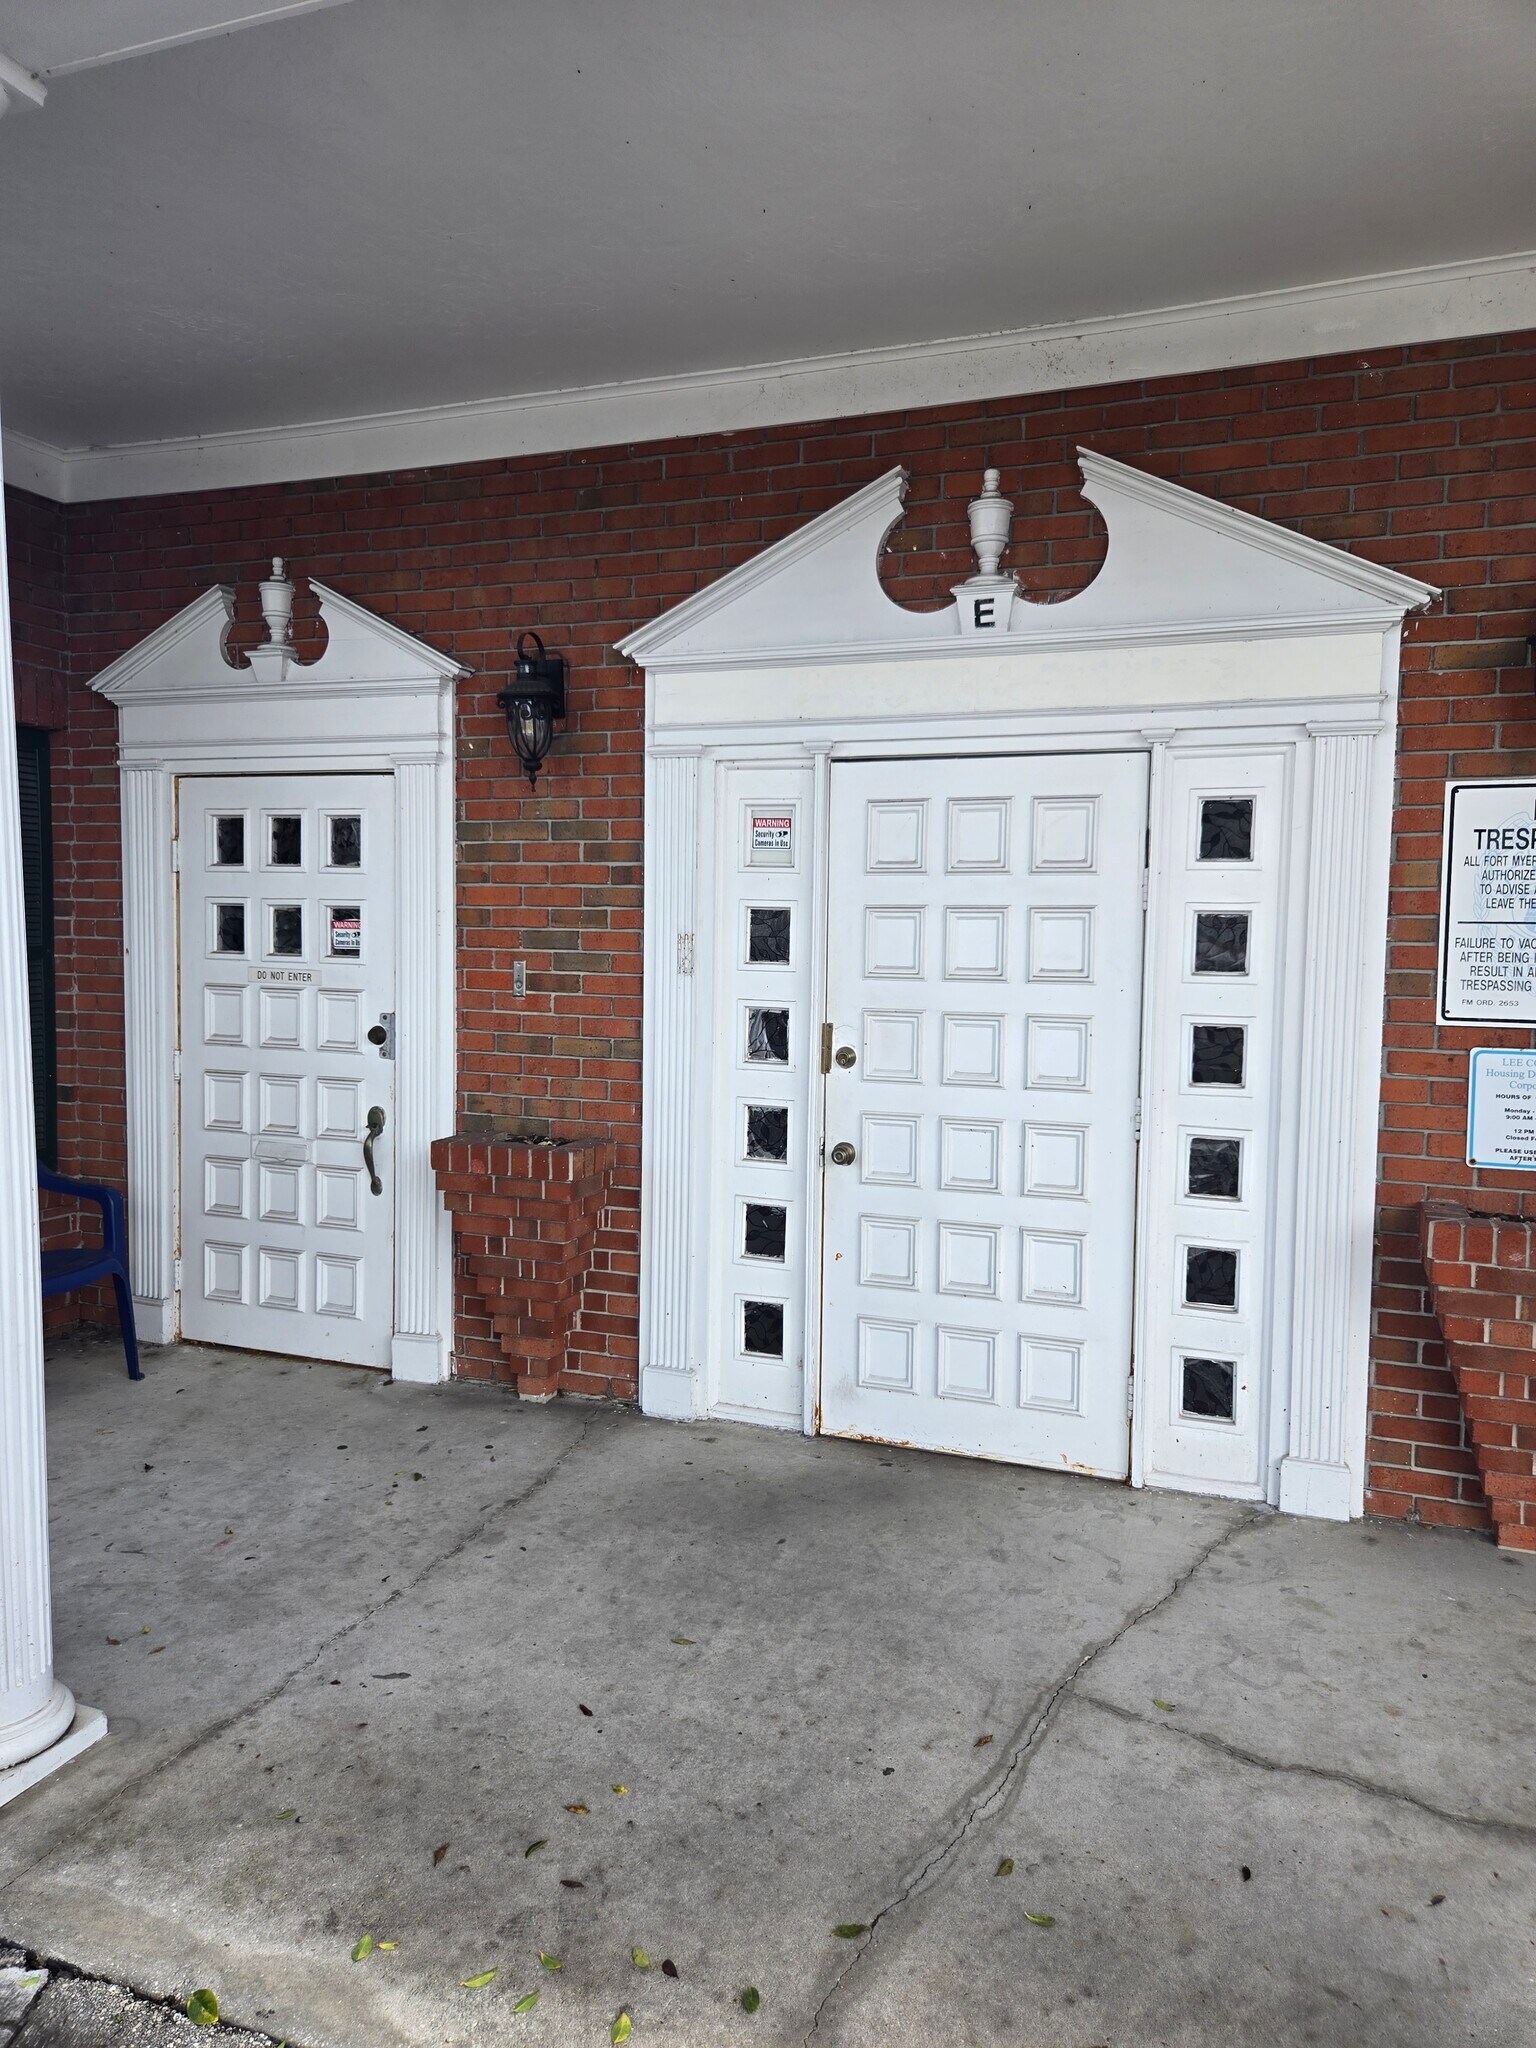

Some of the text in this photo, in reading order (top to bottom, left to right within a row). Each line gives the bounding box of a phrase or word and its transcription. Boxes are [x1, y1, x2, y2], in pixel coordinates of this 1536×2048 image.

[974, 598, 995, 628] E
[755, 819, 790, 828] WARNING
[755, 830, 774, 839] Security
[755, 839, 774, 847] Cameras
[1463, 856, 1480, 867] ALL
[1484, 855, 1509, 867] FORT
[1481, 869, 1536, 881] AUTHORIZE
[1480, 883, 1492, 895] TO
[1496, 883, 1530, 895] ADVISE
[1486, 897, 1514, 909] LEAVE
[1454, 937, 1496, 949] FAILURE
[1500, 937, 1514, 949] TO
[1460, 952, 1493, 963] AFTER
[1497, 952, 1530, 964] BEING
[257, 970, 312, 982] DO NOT ENTER
[1469, 966, 1536, 978] RESULT IN A
[1460, 979, 1532, 992] TRESPASSING
[1502, 1058, 1536, 1068] LEE C
[1486, 1068, 1525, 1080] Housing
